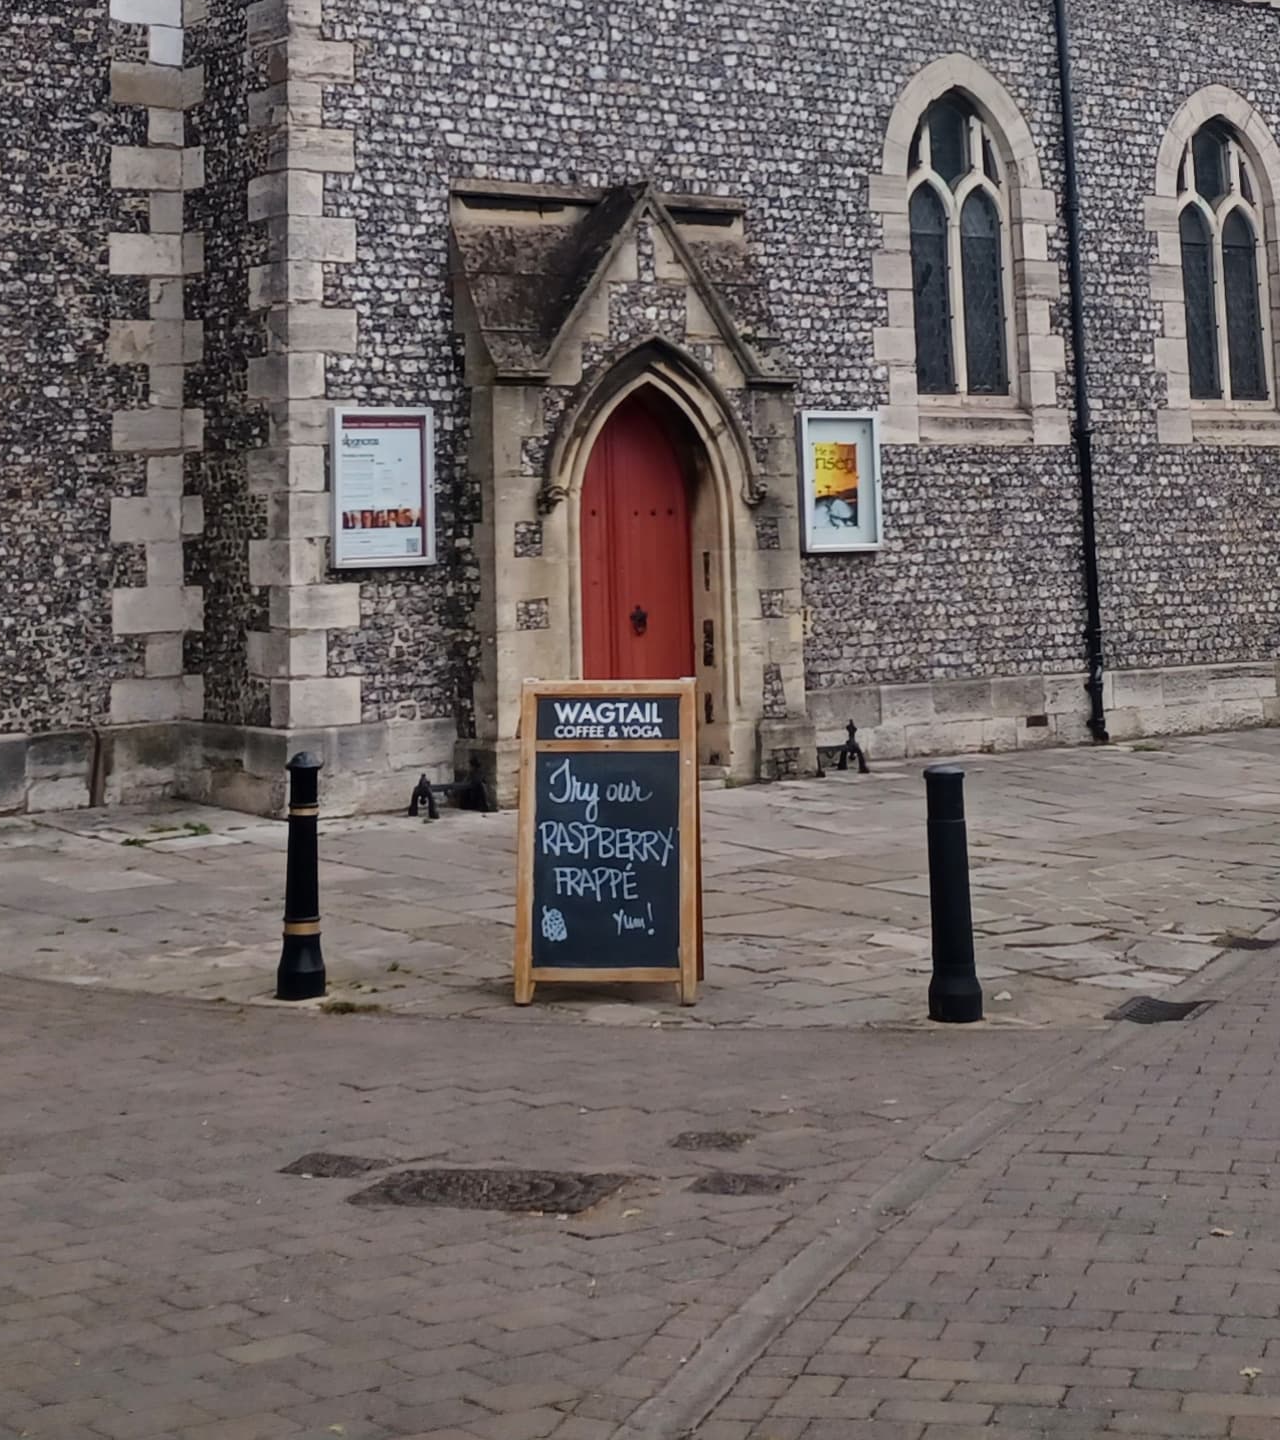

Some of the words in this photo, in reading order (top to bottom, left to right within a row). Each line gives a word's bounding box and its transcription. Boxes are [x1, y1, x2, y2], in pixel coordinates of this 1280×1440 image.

[553, 702, 663, 724] WAGTAIL
[554, 725, 605, 738] COFFEE
[607, 725, 618, 738] &
[621, 725, 662, 738] YOGA
[548, 758, 601, 823] Try
[606, 779, 654, 803] our
[538, 820, 675, 867] RASPBERRY
[553, 862, 639, 902] FRAPPÉ
[612, 902, 655, 936] Yum!
